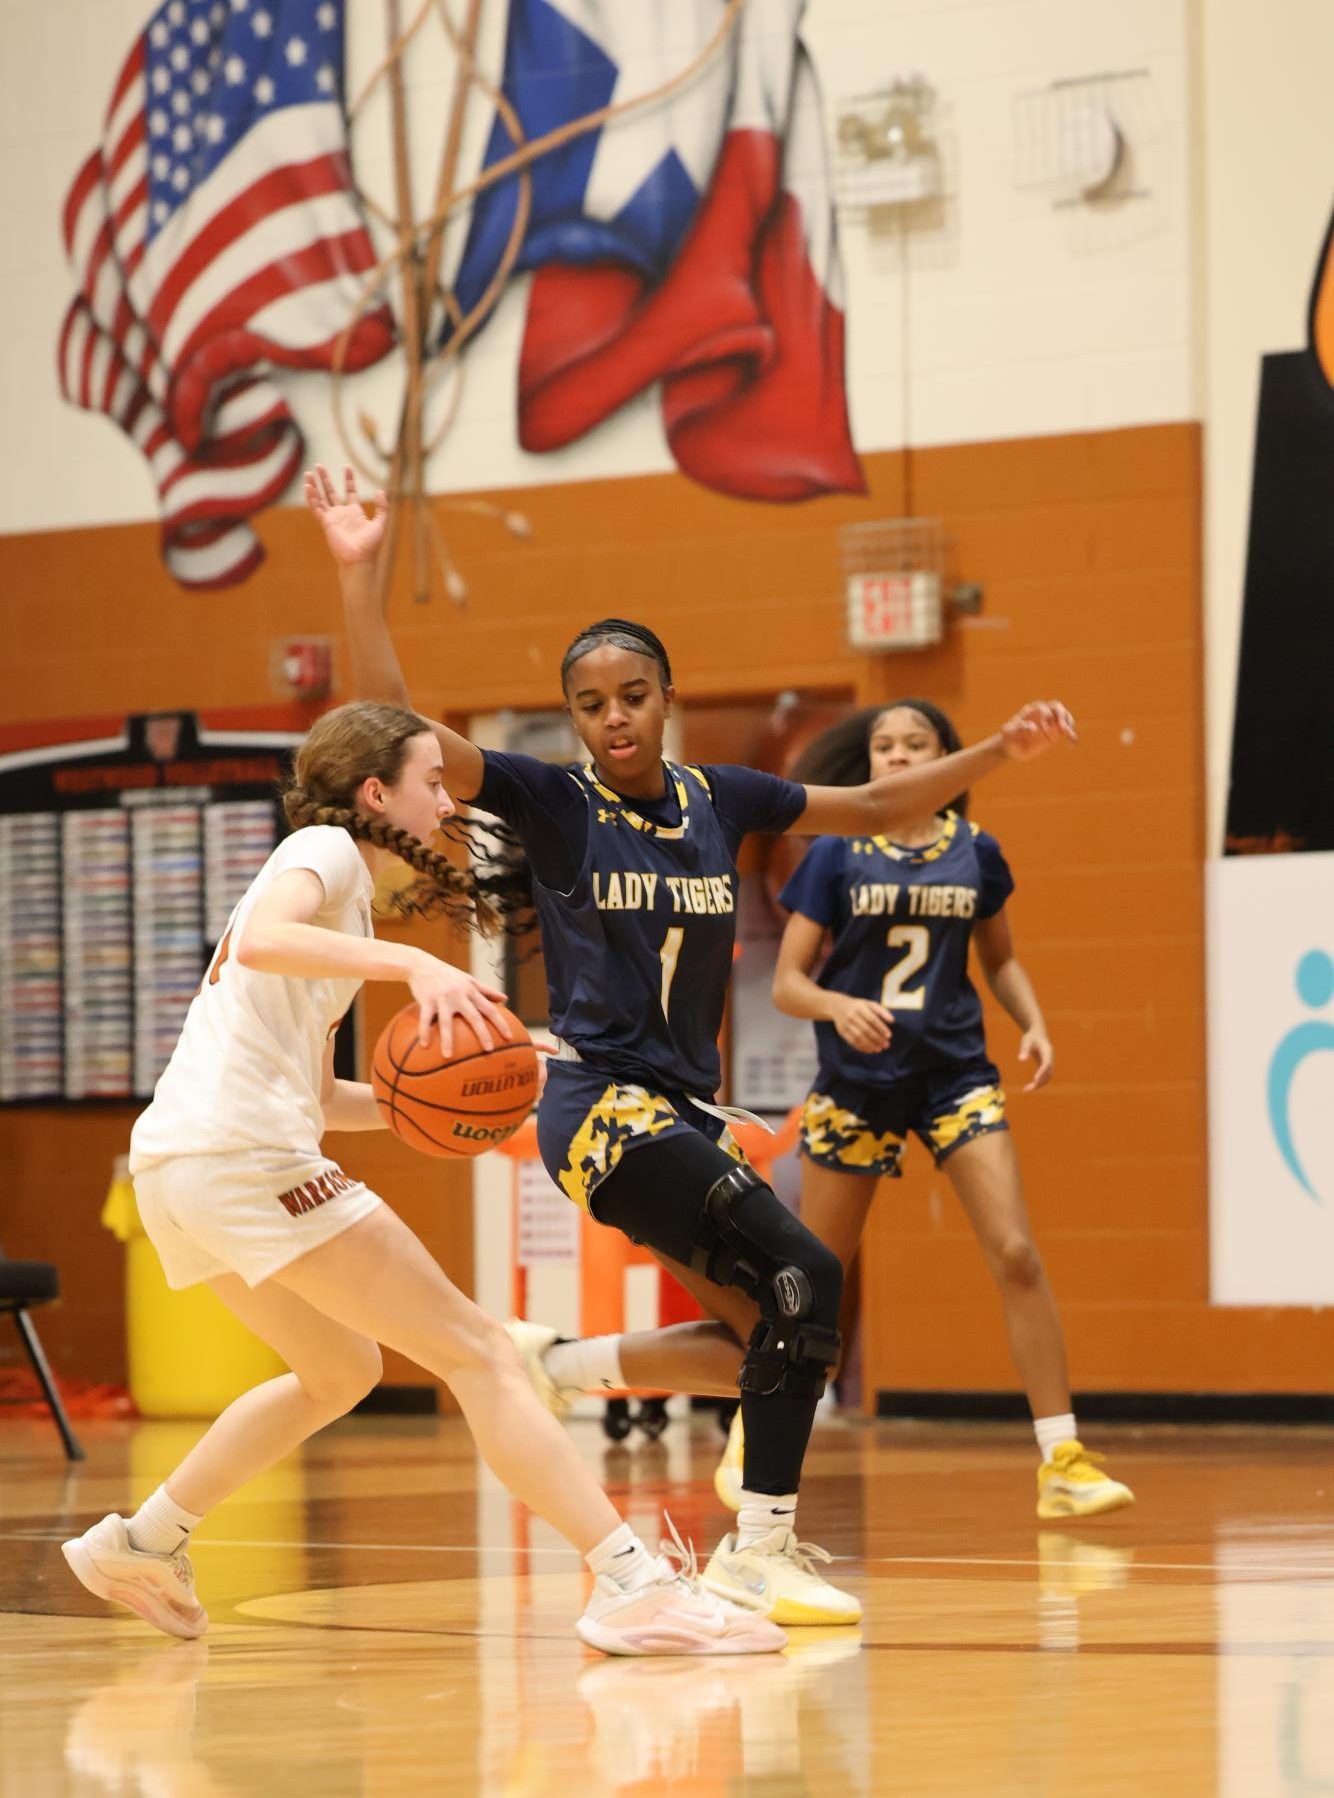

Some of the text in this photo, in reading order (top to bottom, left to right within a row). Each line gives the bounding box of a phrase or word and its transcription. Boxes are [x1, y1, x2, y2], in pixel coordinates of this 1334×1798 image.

[592, 872, 734, 914] LADY TIGERS
[850, 883, 978, 919] LADY TIGERS
[659, 926, 684, 1025] 1
[881, 922, 930, 1010] 2
